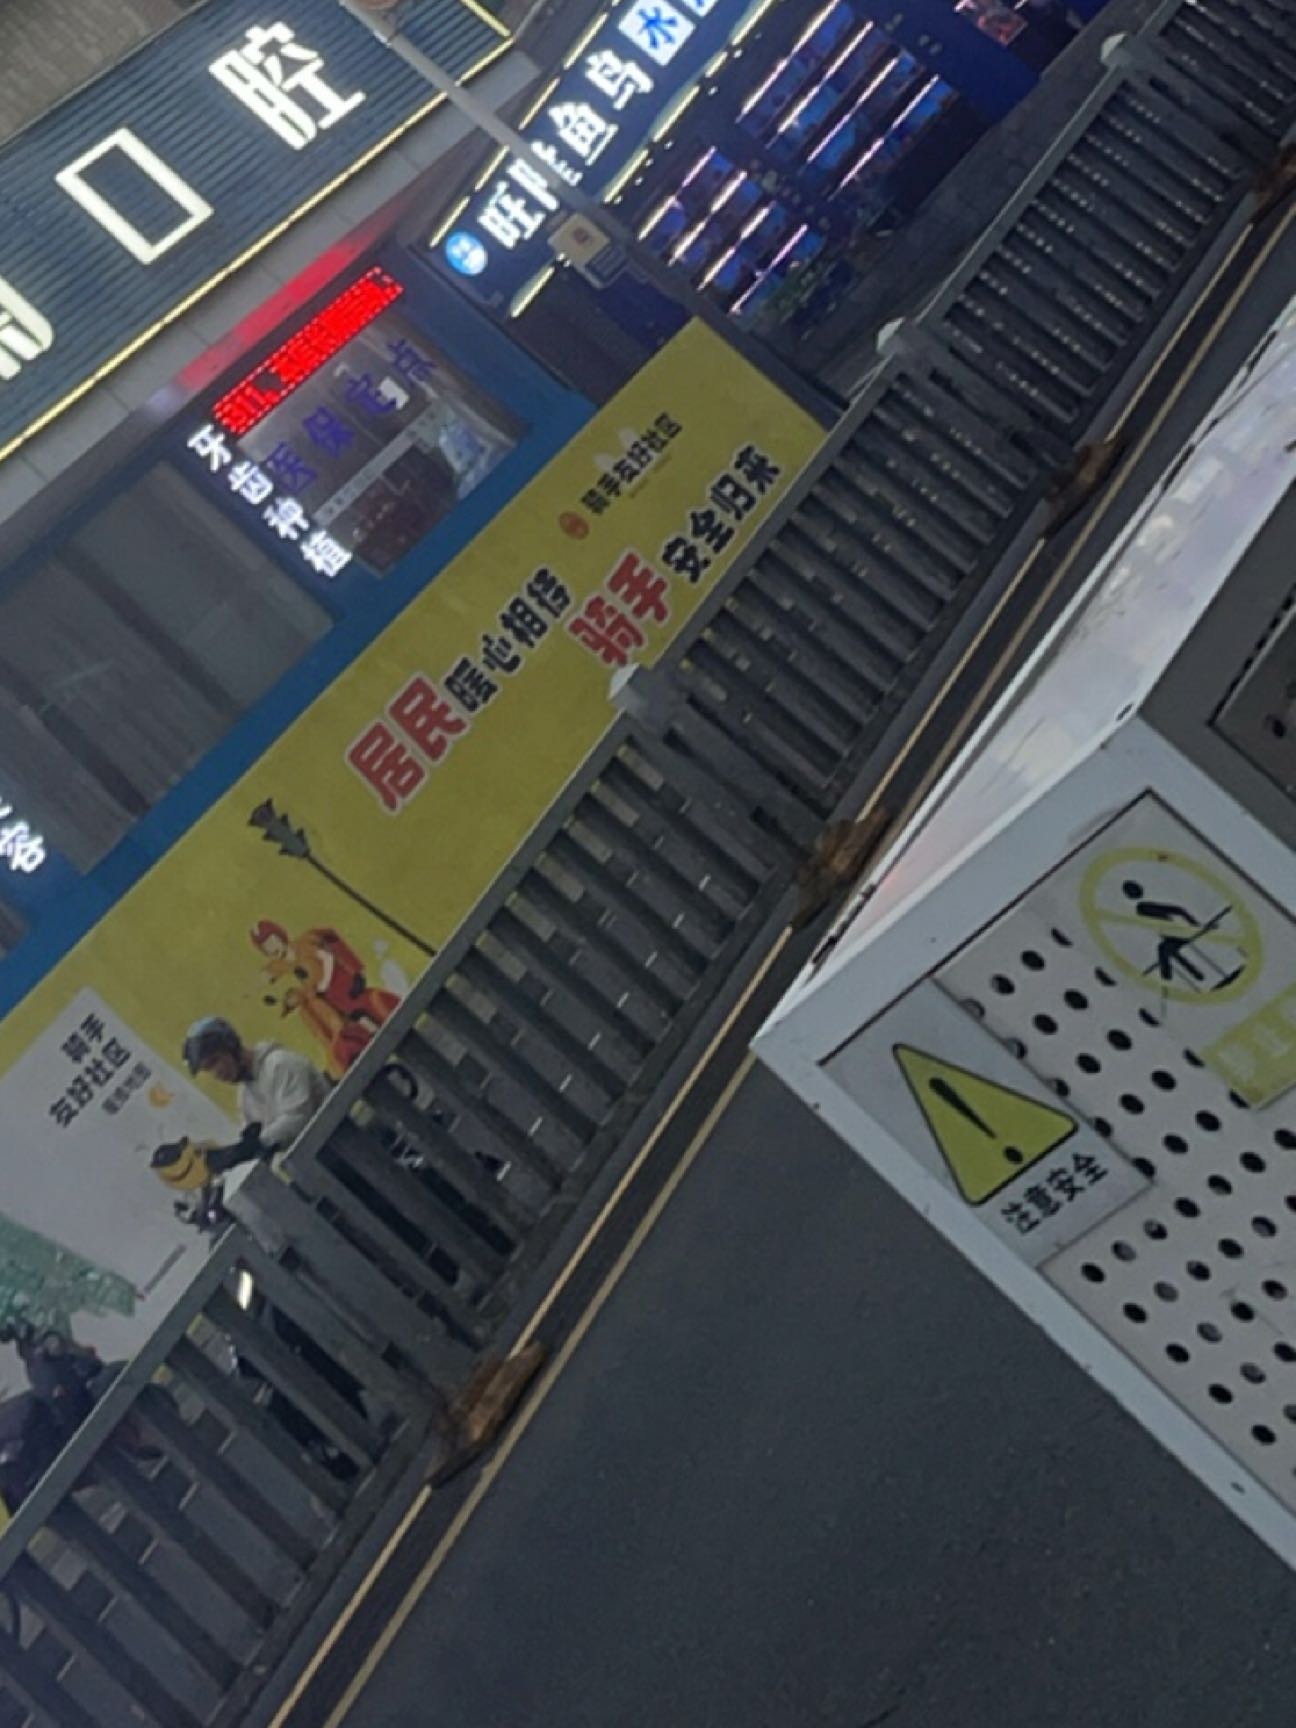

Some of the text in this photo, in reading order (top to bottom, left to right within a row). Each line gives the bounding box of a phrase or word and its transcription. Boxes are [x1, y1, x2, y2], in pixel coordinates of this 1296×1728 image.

[186, 423, 353, 578] 牙齿种植
[580, 411, 683, 515] 骑手友好社区
[568, 445, 781, 667] 骑手安全归来
[347, 568, 572, 811] 居民暖心相待
[49, 1037, 132, 1128] 友好社区
[1000, 1151, 1110, 1236] 注意安全
